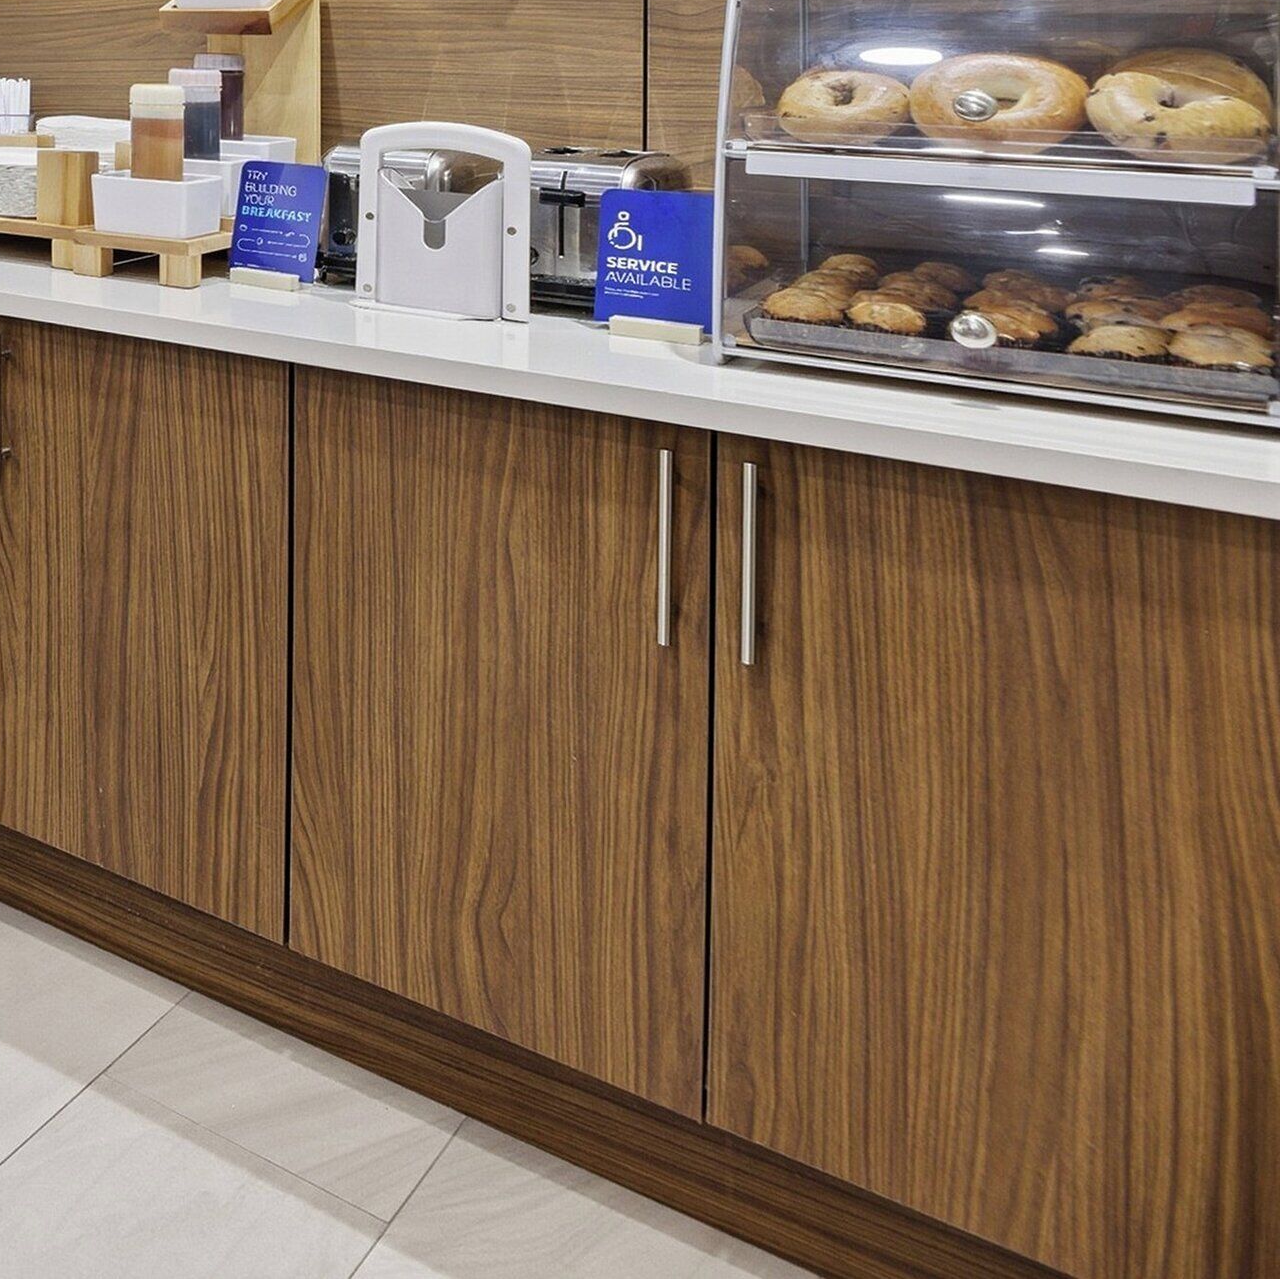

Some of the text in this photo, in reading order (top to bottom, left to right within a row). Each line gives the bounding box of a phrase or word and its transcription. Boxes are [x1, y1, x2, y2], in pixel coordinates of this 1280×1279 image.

[246, 169, 269, 181] TRY
[244, 181, 298, 197] BUILDING
[244, 193, 275, 206] YOUR
[241, 205, 312, 223] BREAKFAST
[606, 255, 679, 275] SERVICE
[604, 271, 692, 292] AVAILABLE
